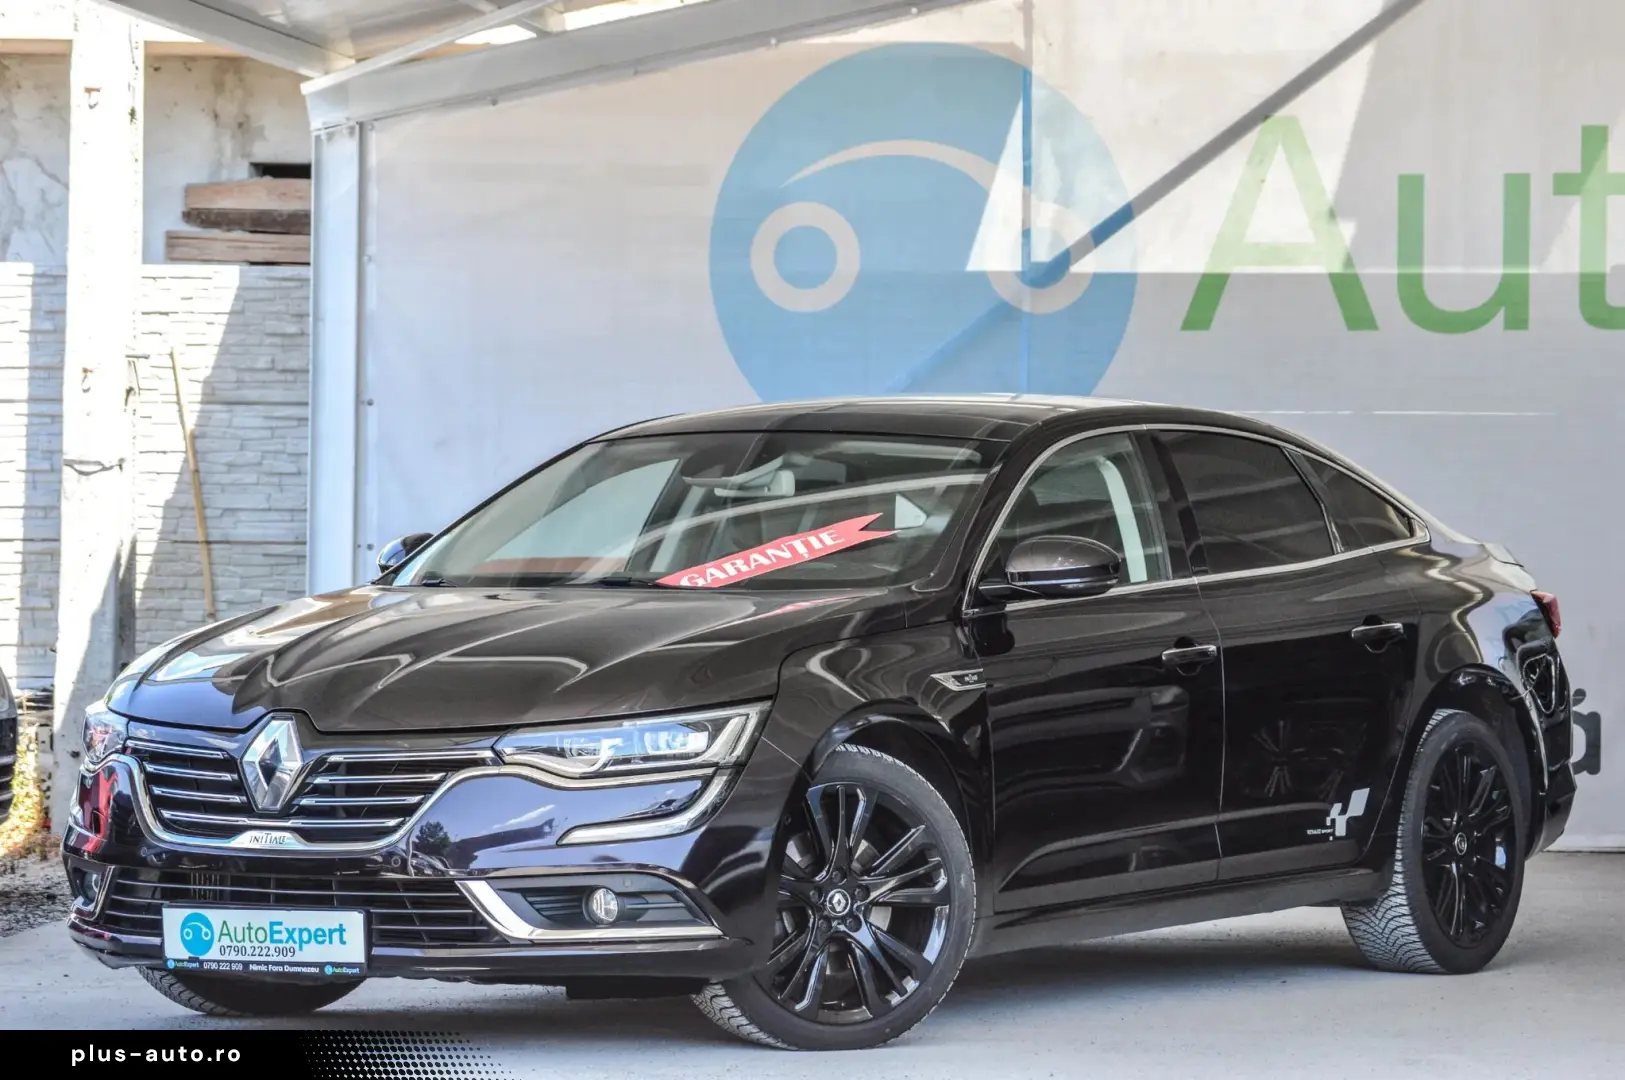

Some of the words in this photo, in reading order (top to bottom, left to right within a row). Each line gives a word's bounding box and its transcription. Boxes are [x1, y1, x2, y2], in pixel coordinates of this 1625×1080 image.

[1179, 115, 1625, 335] Aut
[217, 919, 347, 952] AutoExpert
[219, 945, 296, 958] 0790.222.909
[203, 961, 218, 970] 0790
[219, 962, 231, 970] 222
[231, 963, 243, 971] 909
[249, 963, 267, 972] Nimic
[284, 965, 319, 973] Dumnezeu
[333, 966, 360, 975] AutoExpert
